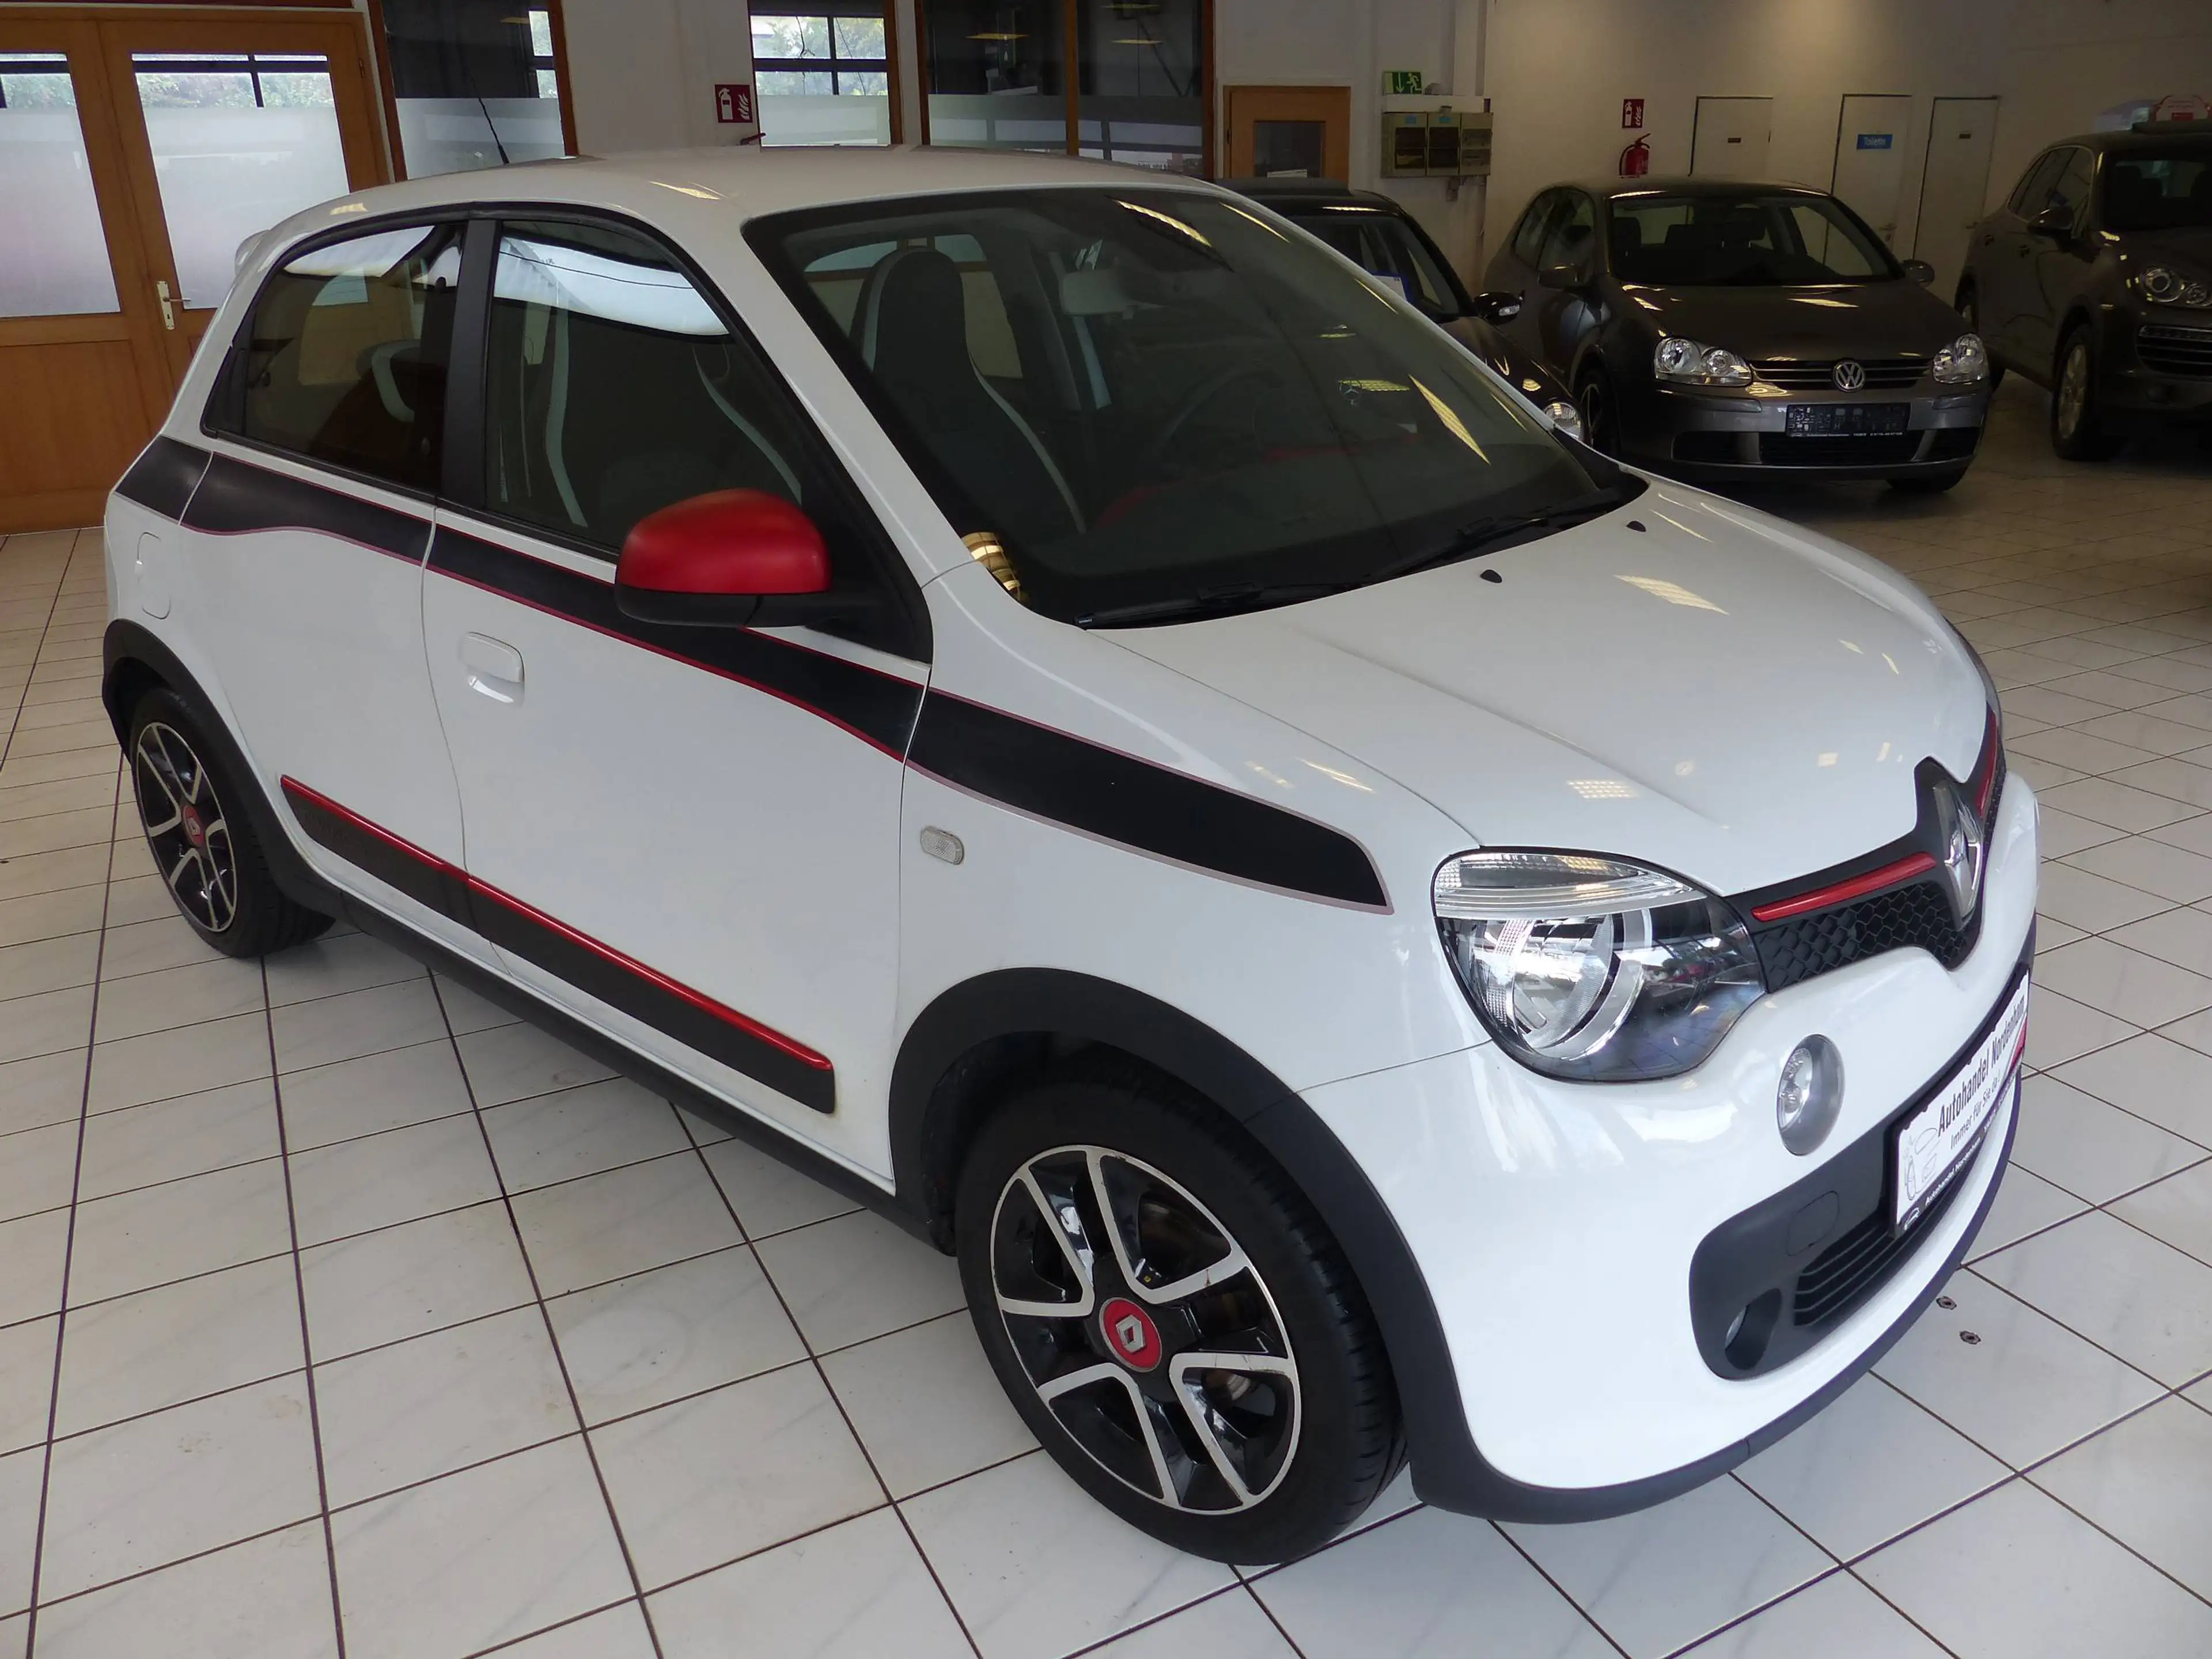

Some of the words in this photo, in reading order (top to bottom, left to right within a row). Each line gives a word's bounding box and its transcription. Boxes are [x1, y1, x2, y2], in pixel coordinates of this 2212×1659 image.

[1938, 1048, 1989, 1138] Autohandel
[1950, 1114, 1972, 1150] Immer
[1973, 1101, 1982, 1121] für
[1982, 1087, 1991, 1108] Sie
